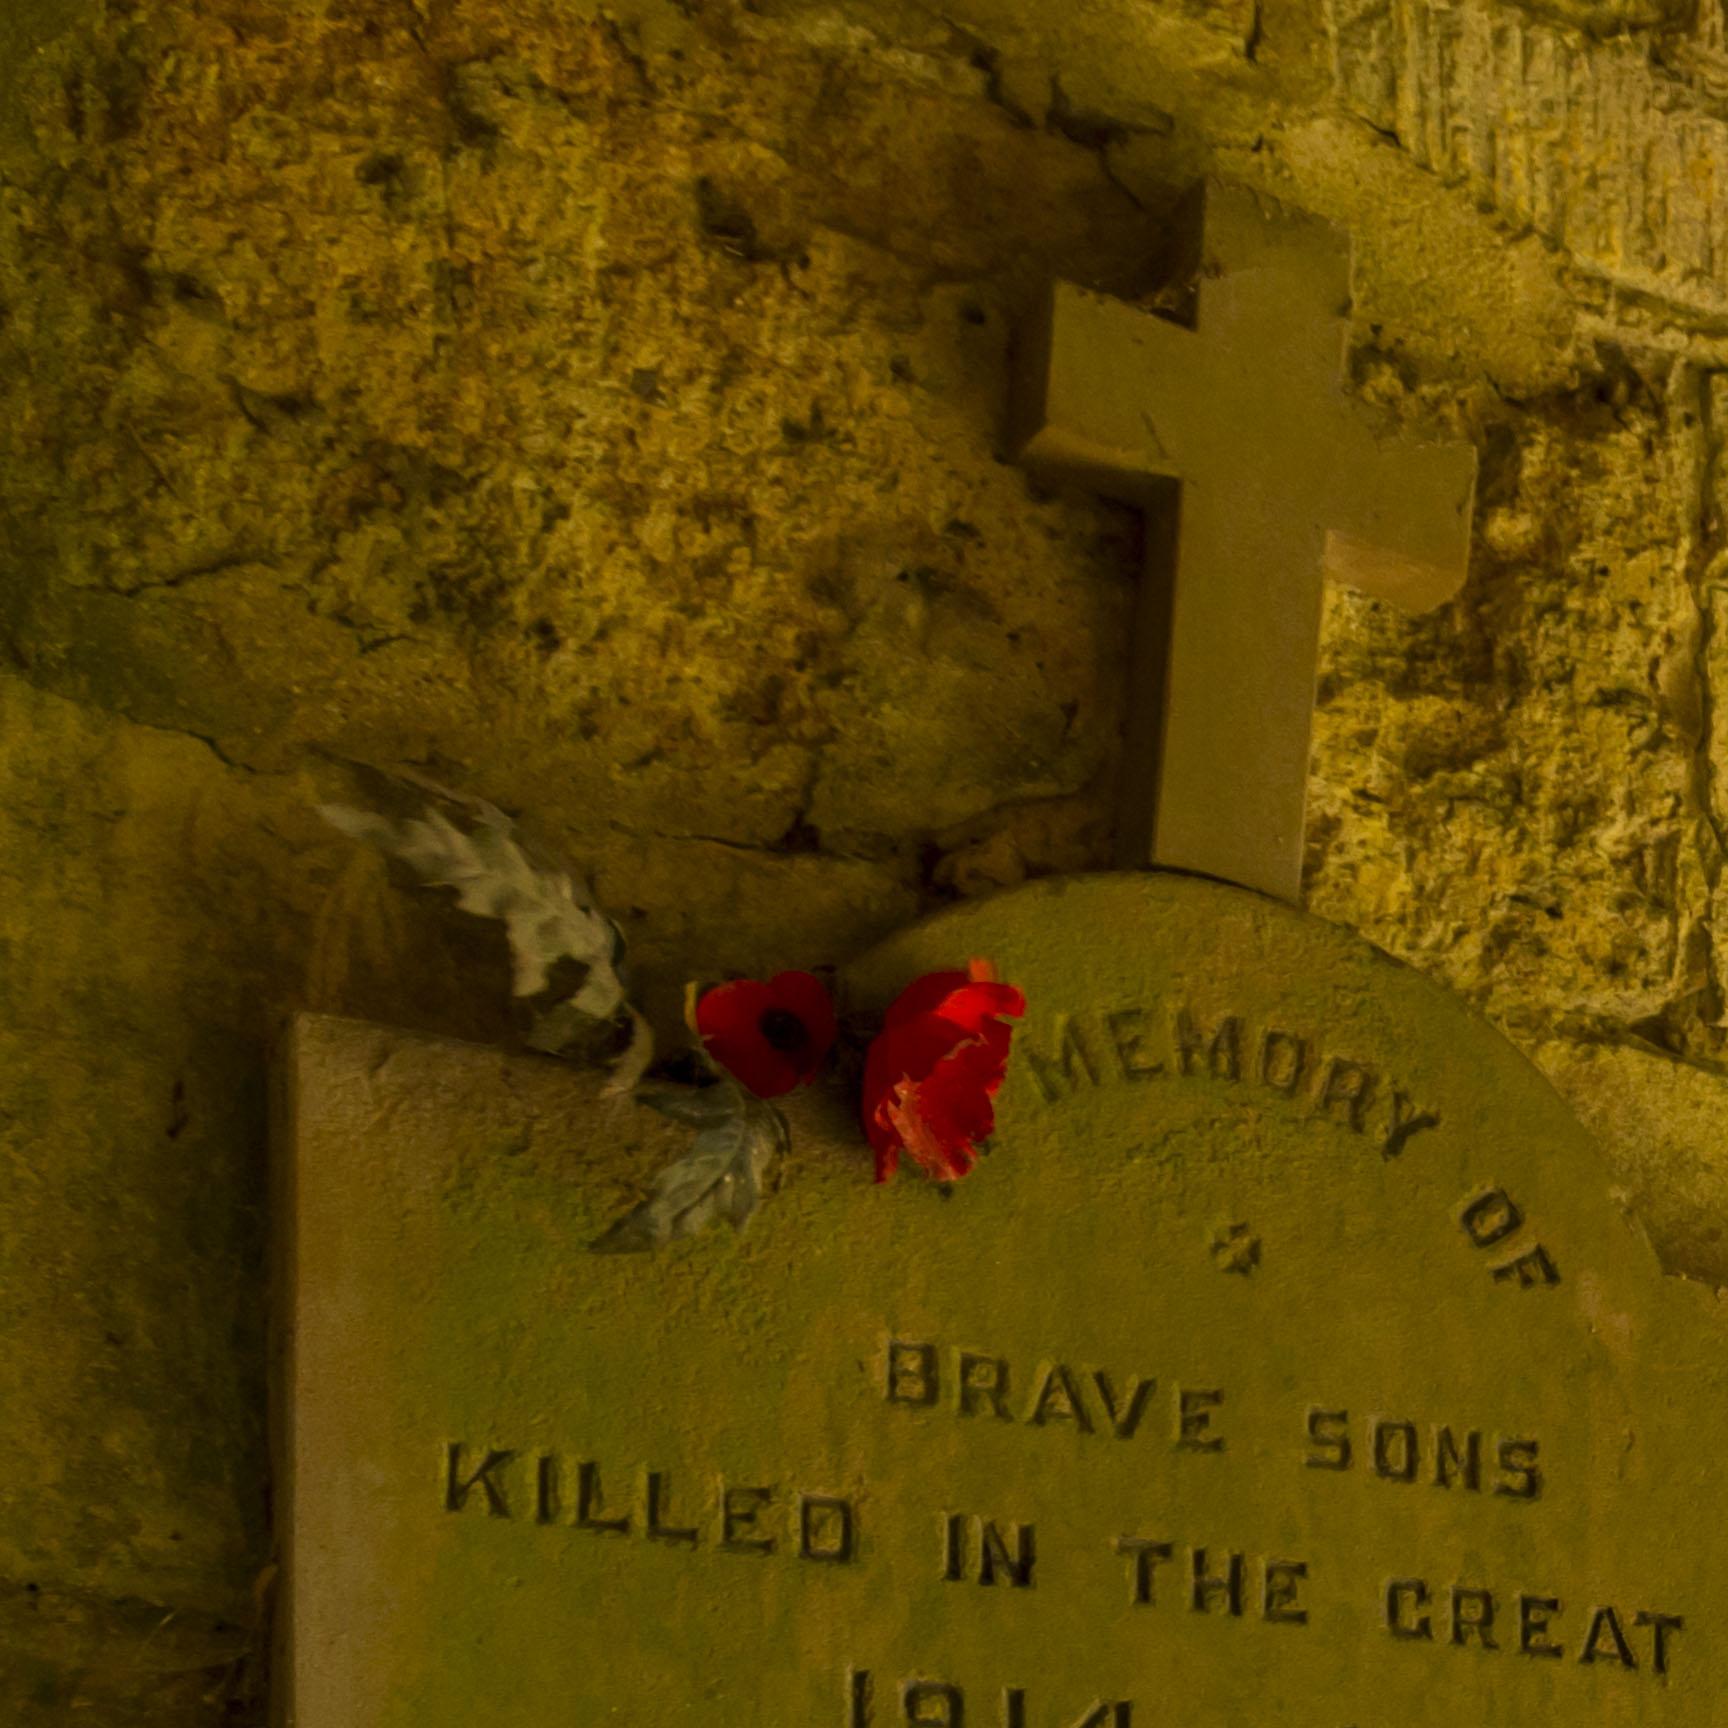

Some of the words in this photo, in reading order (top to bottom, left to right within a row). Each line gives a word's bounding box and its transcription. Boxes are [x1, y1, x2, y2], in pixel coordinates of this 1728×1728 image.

[1022, 1003, 1441, 1163] MEMORY
[1460, 1185, 1561, 1289] OF
[887, 1340, 1225, 1452] BRAVE
[1305, 1408, 1543, 1500] SONS
[441, 1441, 858, 1563] KILLED
[943, 1510, 1037, 1588] IN
[1112, 1535, 1310, 1625] THE
[1385, 1577, 1686, 1676] GREAT
